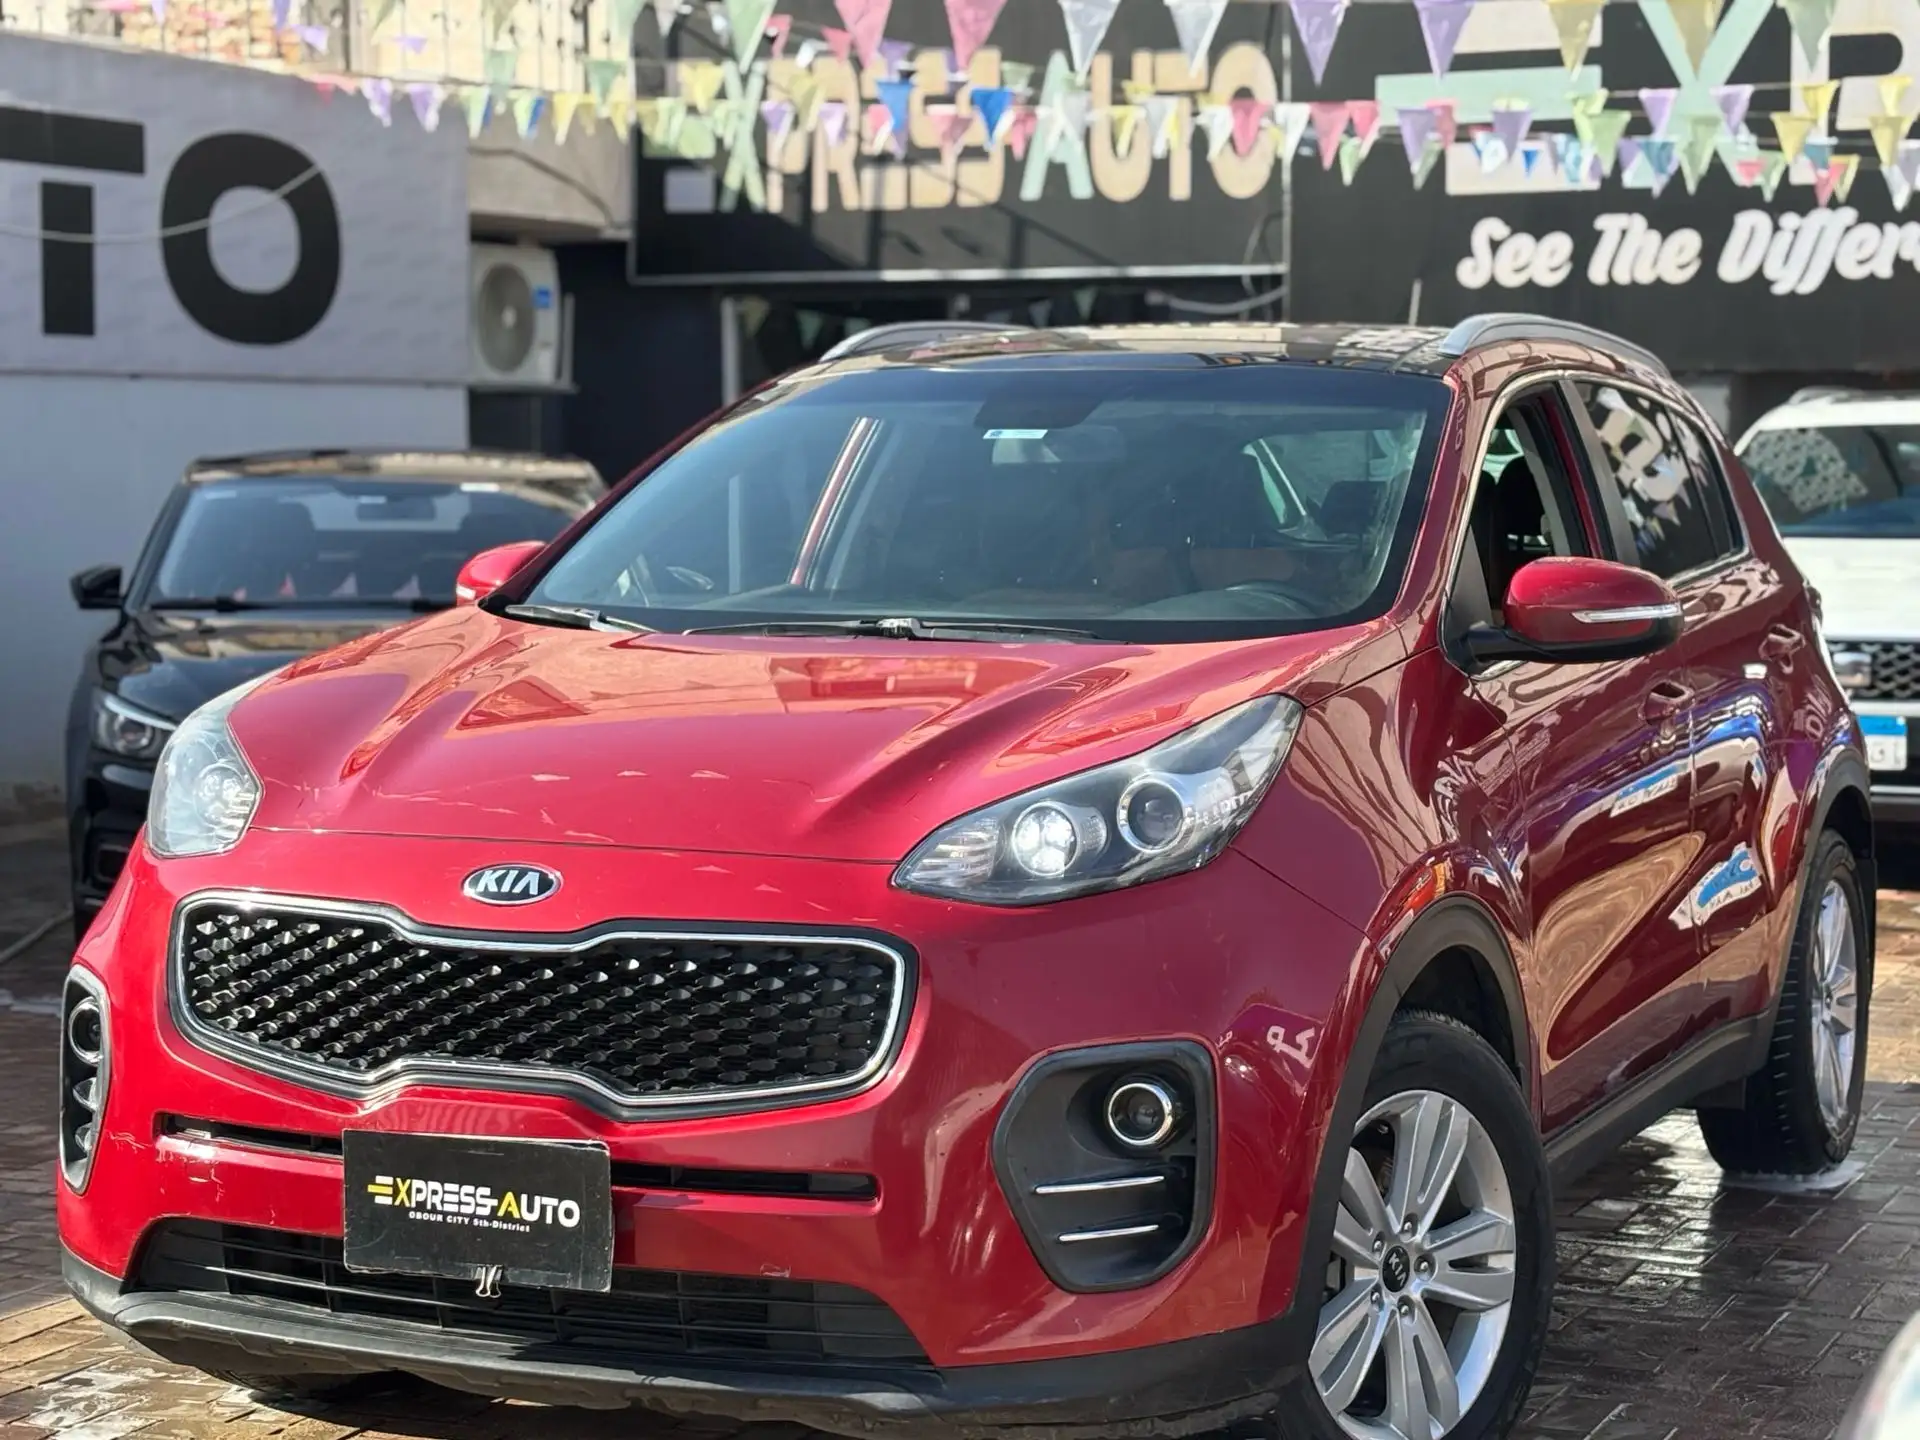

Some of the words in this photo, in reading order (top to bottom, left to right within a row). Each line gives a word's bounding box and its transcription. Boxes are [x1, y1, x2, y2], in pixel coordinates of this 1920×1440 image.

[1019, 42, 1278, 202] AUTO
[0, 105, 342, 346] TO
[1456, 216, 1575, 290] See
[1587, 212, 1702, 287] The
[1716, 207, 1920, 295] Differ
[475, 869, 541, 896] KIA
[408, 1210, 443, 1224] OBOUR
[446, 1215, 470, 1226] CITY
[1388, 1253, 1408, 1286] KIA
